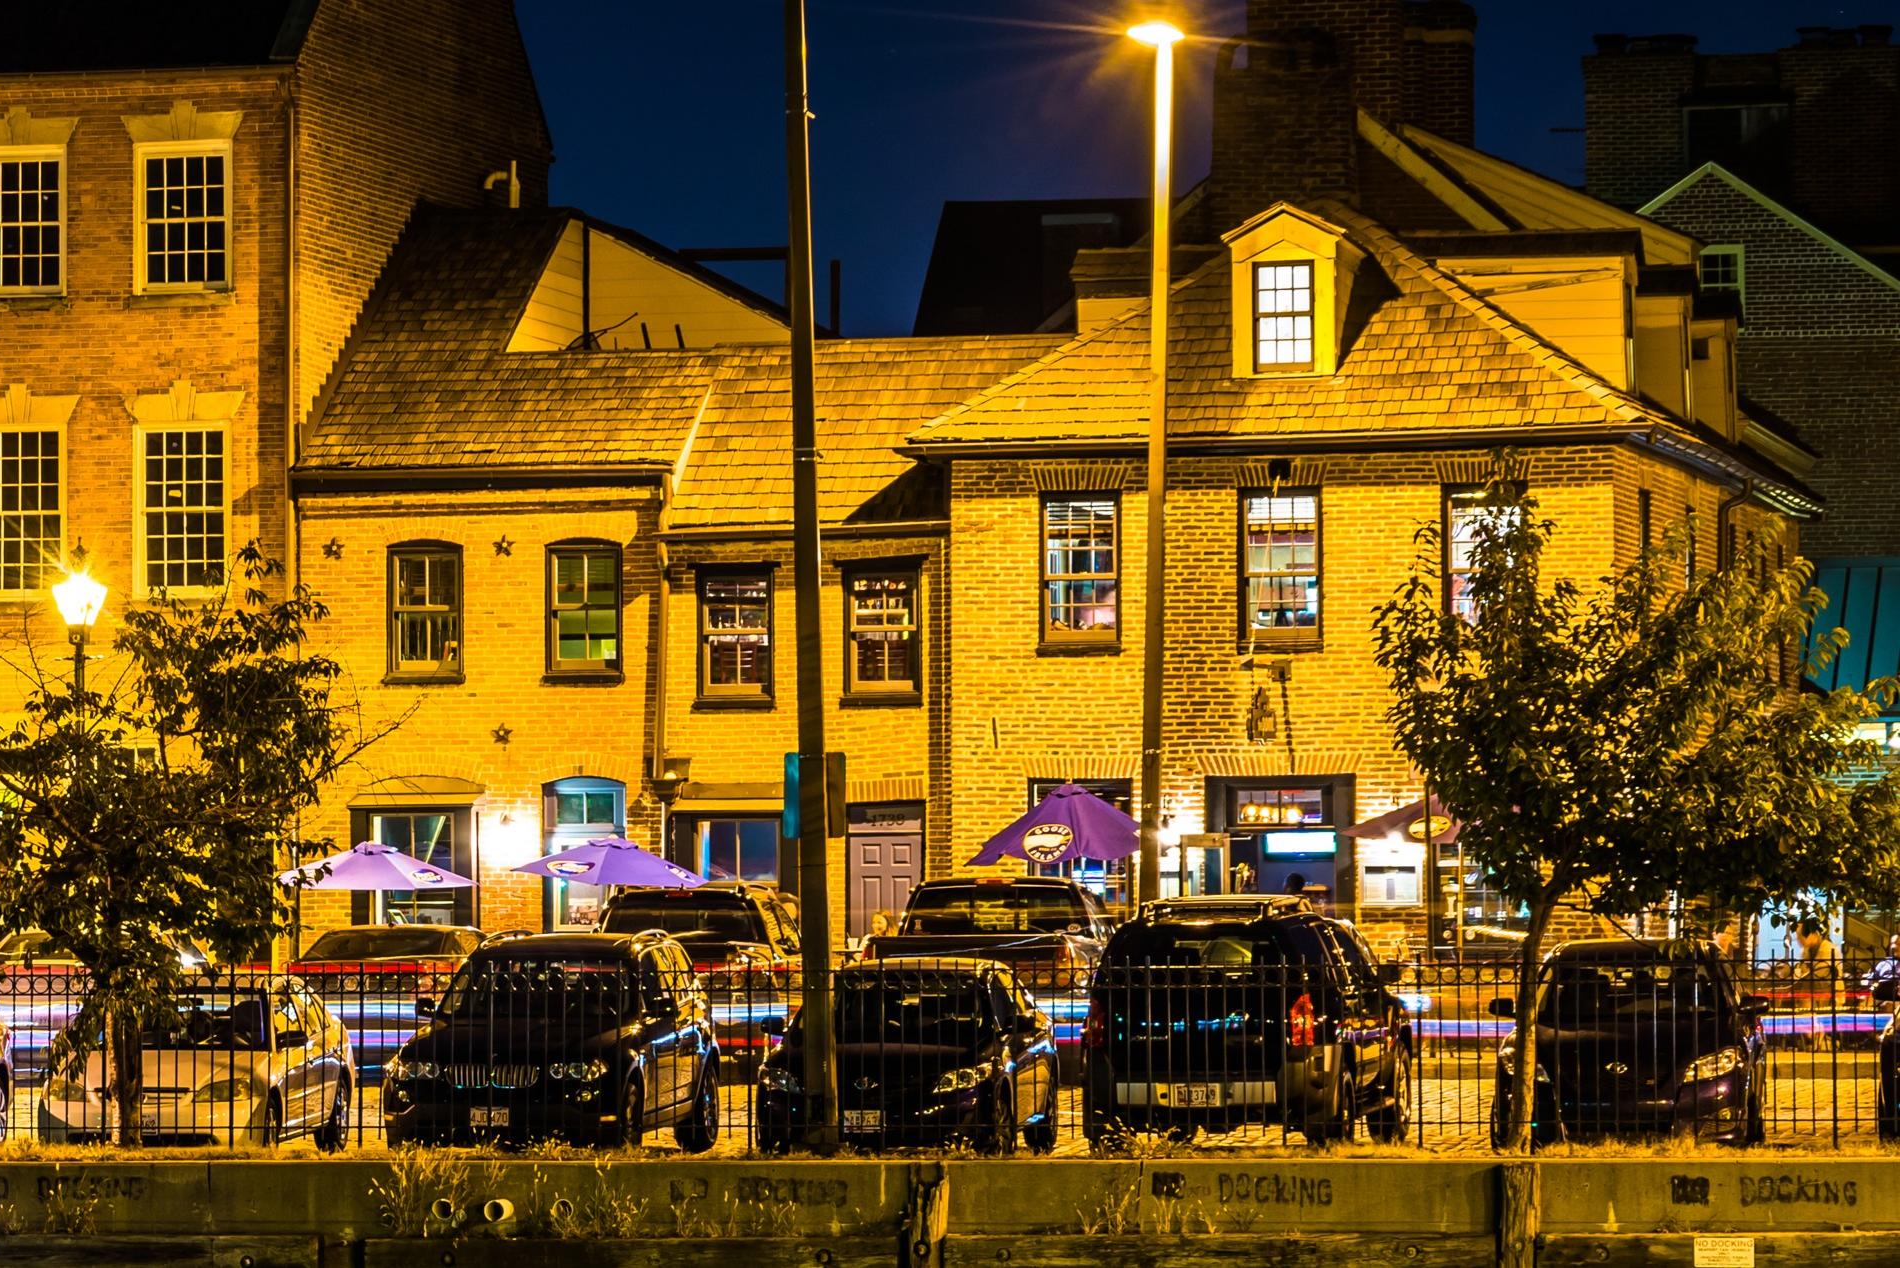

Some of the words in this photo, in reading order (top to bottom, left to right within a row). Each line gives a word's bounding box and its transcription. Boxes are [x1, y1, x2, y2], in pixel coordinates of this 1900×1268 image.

[1739, 1174, 1857, 1207] DOCKING
[1695, 1240, 1708, 1248] NO
[1710, 1240, 1753, 1248] DOCKING
